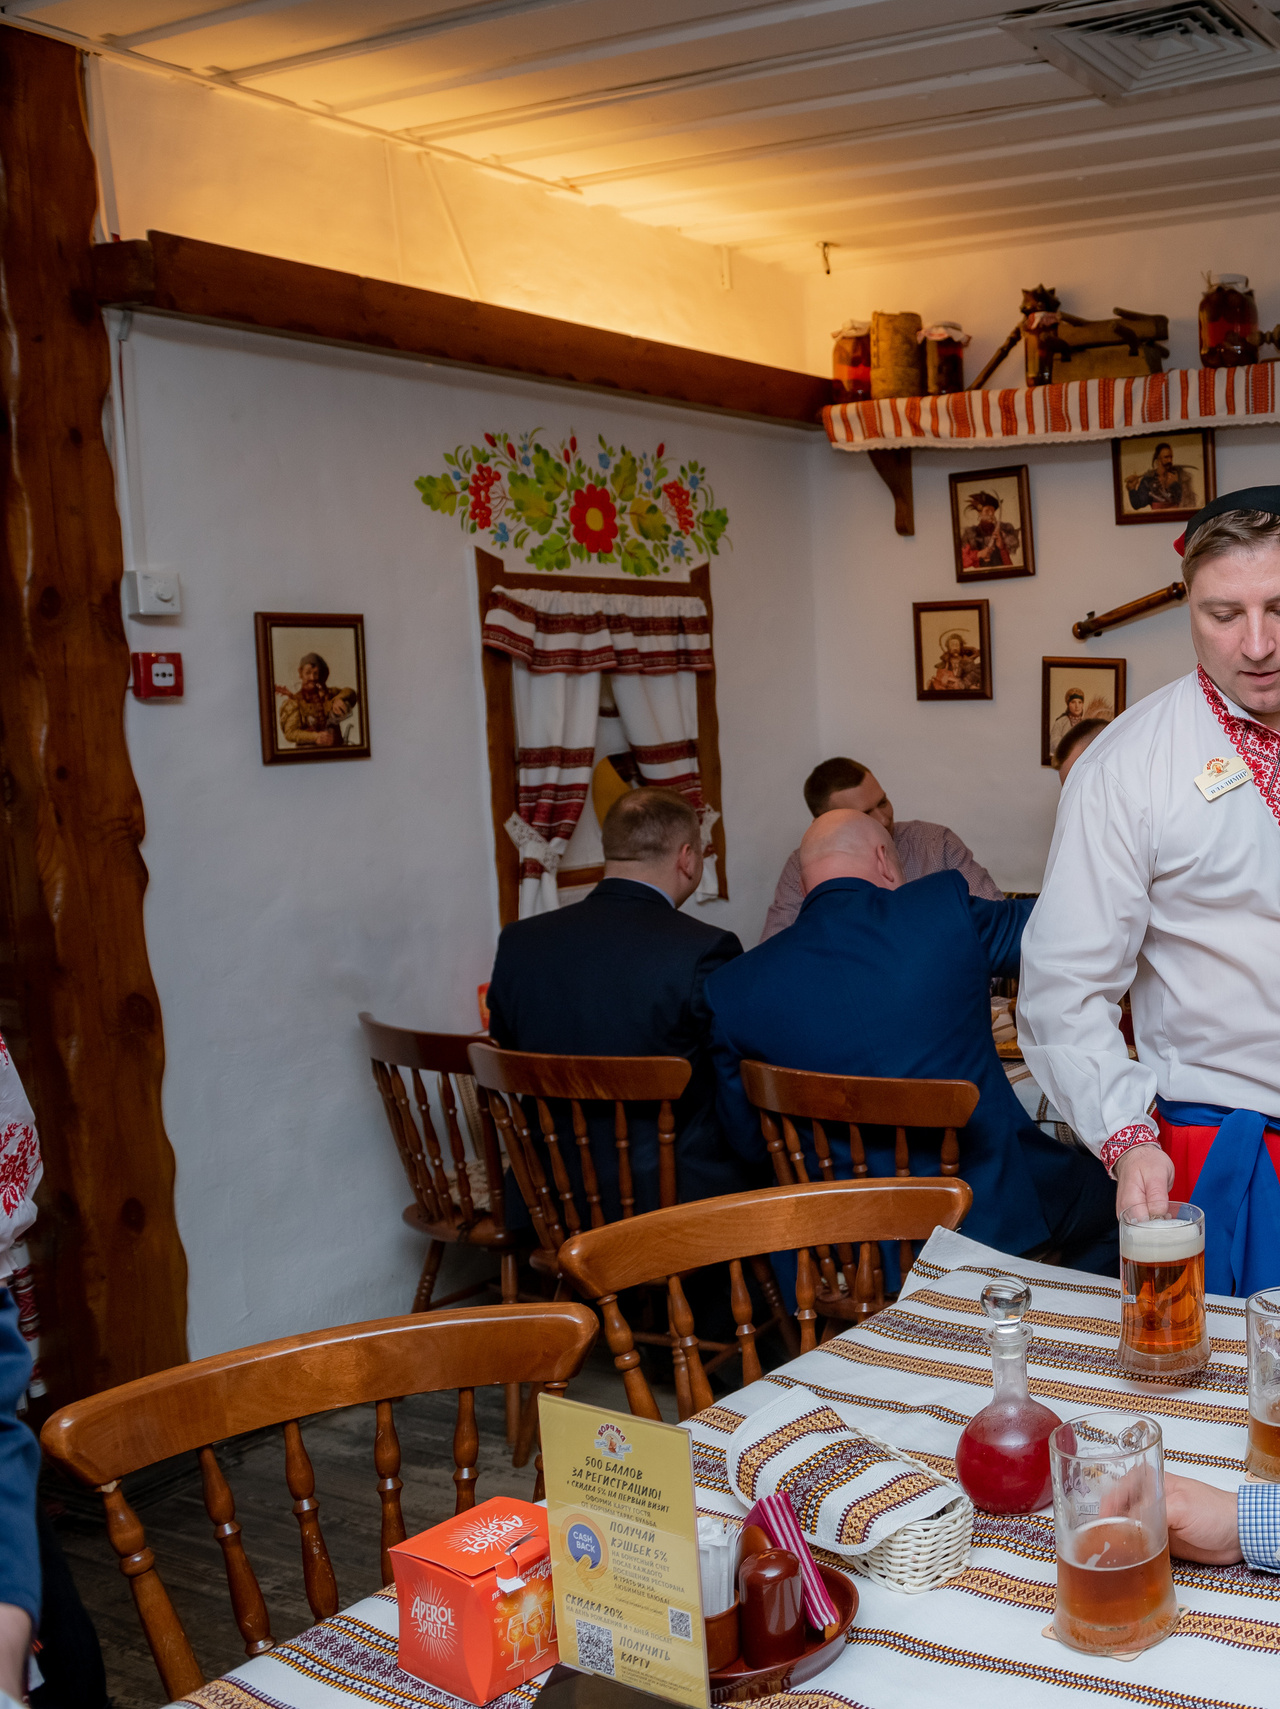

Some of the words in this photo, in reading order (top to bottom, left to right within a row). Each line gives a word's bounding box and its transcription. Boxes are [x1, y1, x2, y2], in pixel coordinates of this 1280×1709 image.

[598, 1424, 626, 1442] КОРЧМА
[585, 1456, 603, 1469] 500
[605, 1462, 643, 1480] БАЛЛОВ
[572, 1467, 582, 1478] ЗА
[586, 1471, 661, 1500] РЕГИСТРАЦИЮ!
[571, 1480, 596, 1493] СКИДКА
[597, 1487, 606, 1496] 5%
[608, 1490, 617, 1499] НА
[618, 1493, 646, 1506] ПЕРВЫЙ
[648, 1501, 670, 1513] ВИЗИТ
[585, 1494, 612, 1507] ОФОРМИ
[613, 1502, 631, 1511] КАРТУ
[633, 1507, 651, 1518] ГОСТЯ
[590, 1504, 615, 1515] КОРЧМЫ
[617, 1511, 634, 1520] ТАРАС
[635, 1516, 657, 1527] БУЛЬБА
[462, 1515, 523, 1553] APEROL
[573, 1531, 593, 1543] CASH
[610, 1521, 655, 1543] ПОЛУЧАЙ
[576, 1540, 596, 1553] BACK
[610, 1537, 651, 1558] КЭШБЕК
[654, 1548, 668, 1563] 5%
[612, 1558, 632, 1569] ПОСЛЕ
[633, 1565, 663, 1579] КАЖДОГО
[621, 1553, 654, 1567] БОНУСНЫЙ
[655, 1563, 670, 1572] СЧЕТ
[613, 1566, 650, 1582] ПОСЕЩЕНИЯ
[651, 1578, 685, 1593] РЕСТОРАНА
[411, 1596, 454, 1626] APEROL
[565, 1593, 602, 1612] СКИДКА
[604, 1606, 624, 1620] 20%
[575, 1608, 589, 1618] ДЕНЬ
[591, 1612, 622, 1627] РОЖДЕНИЯ
[634, 1627, 649, 1637] ДНЕЙ
[620, 1636, 670, 1661] ПОЛУЧИТЬ
[621, 1652, 650, 1668] КАРТУ
